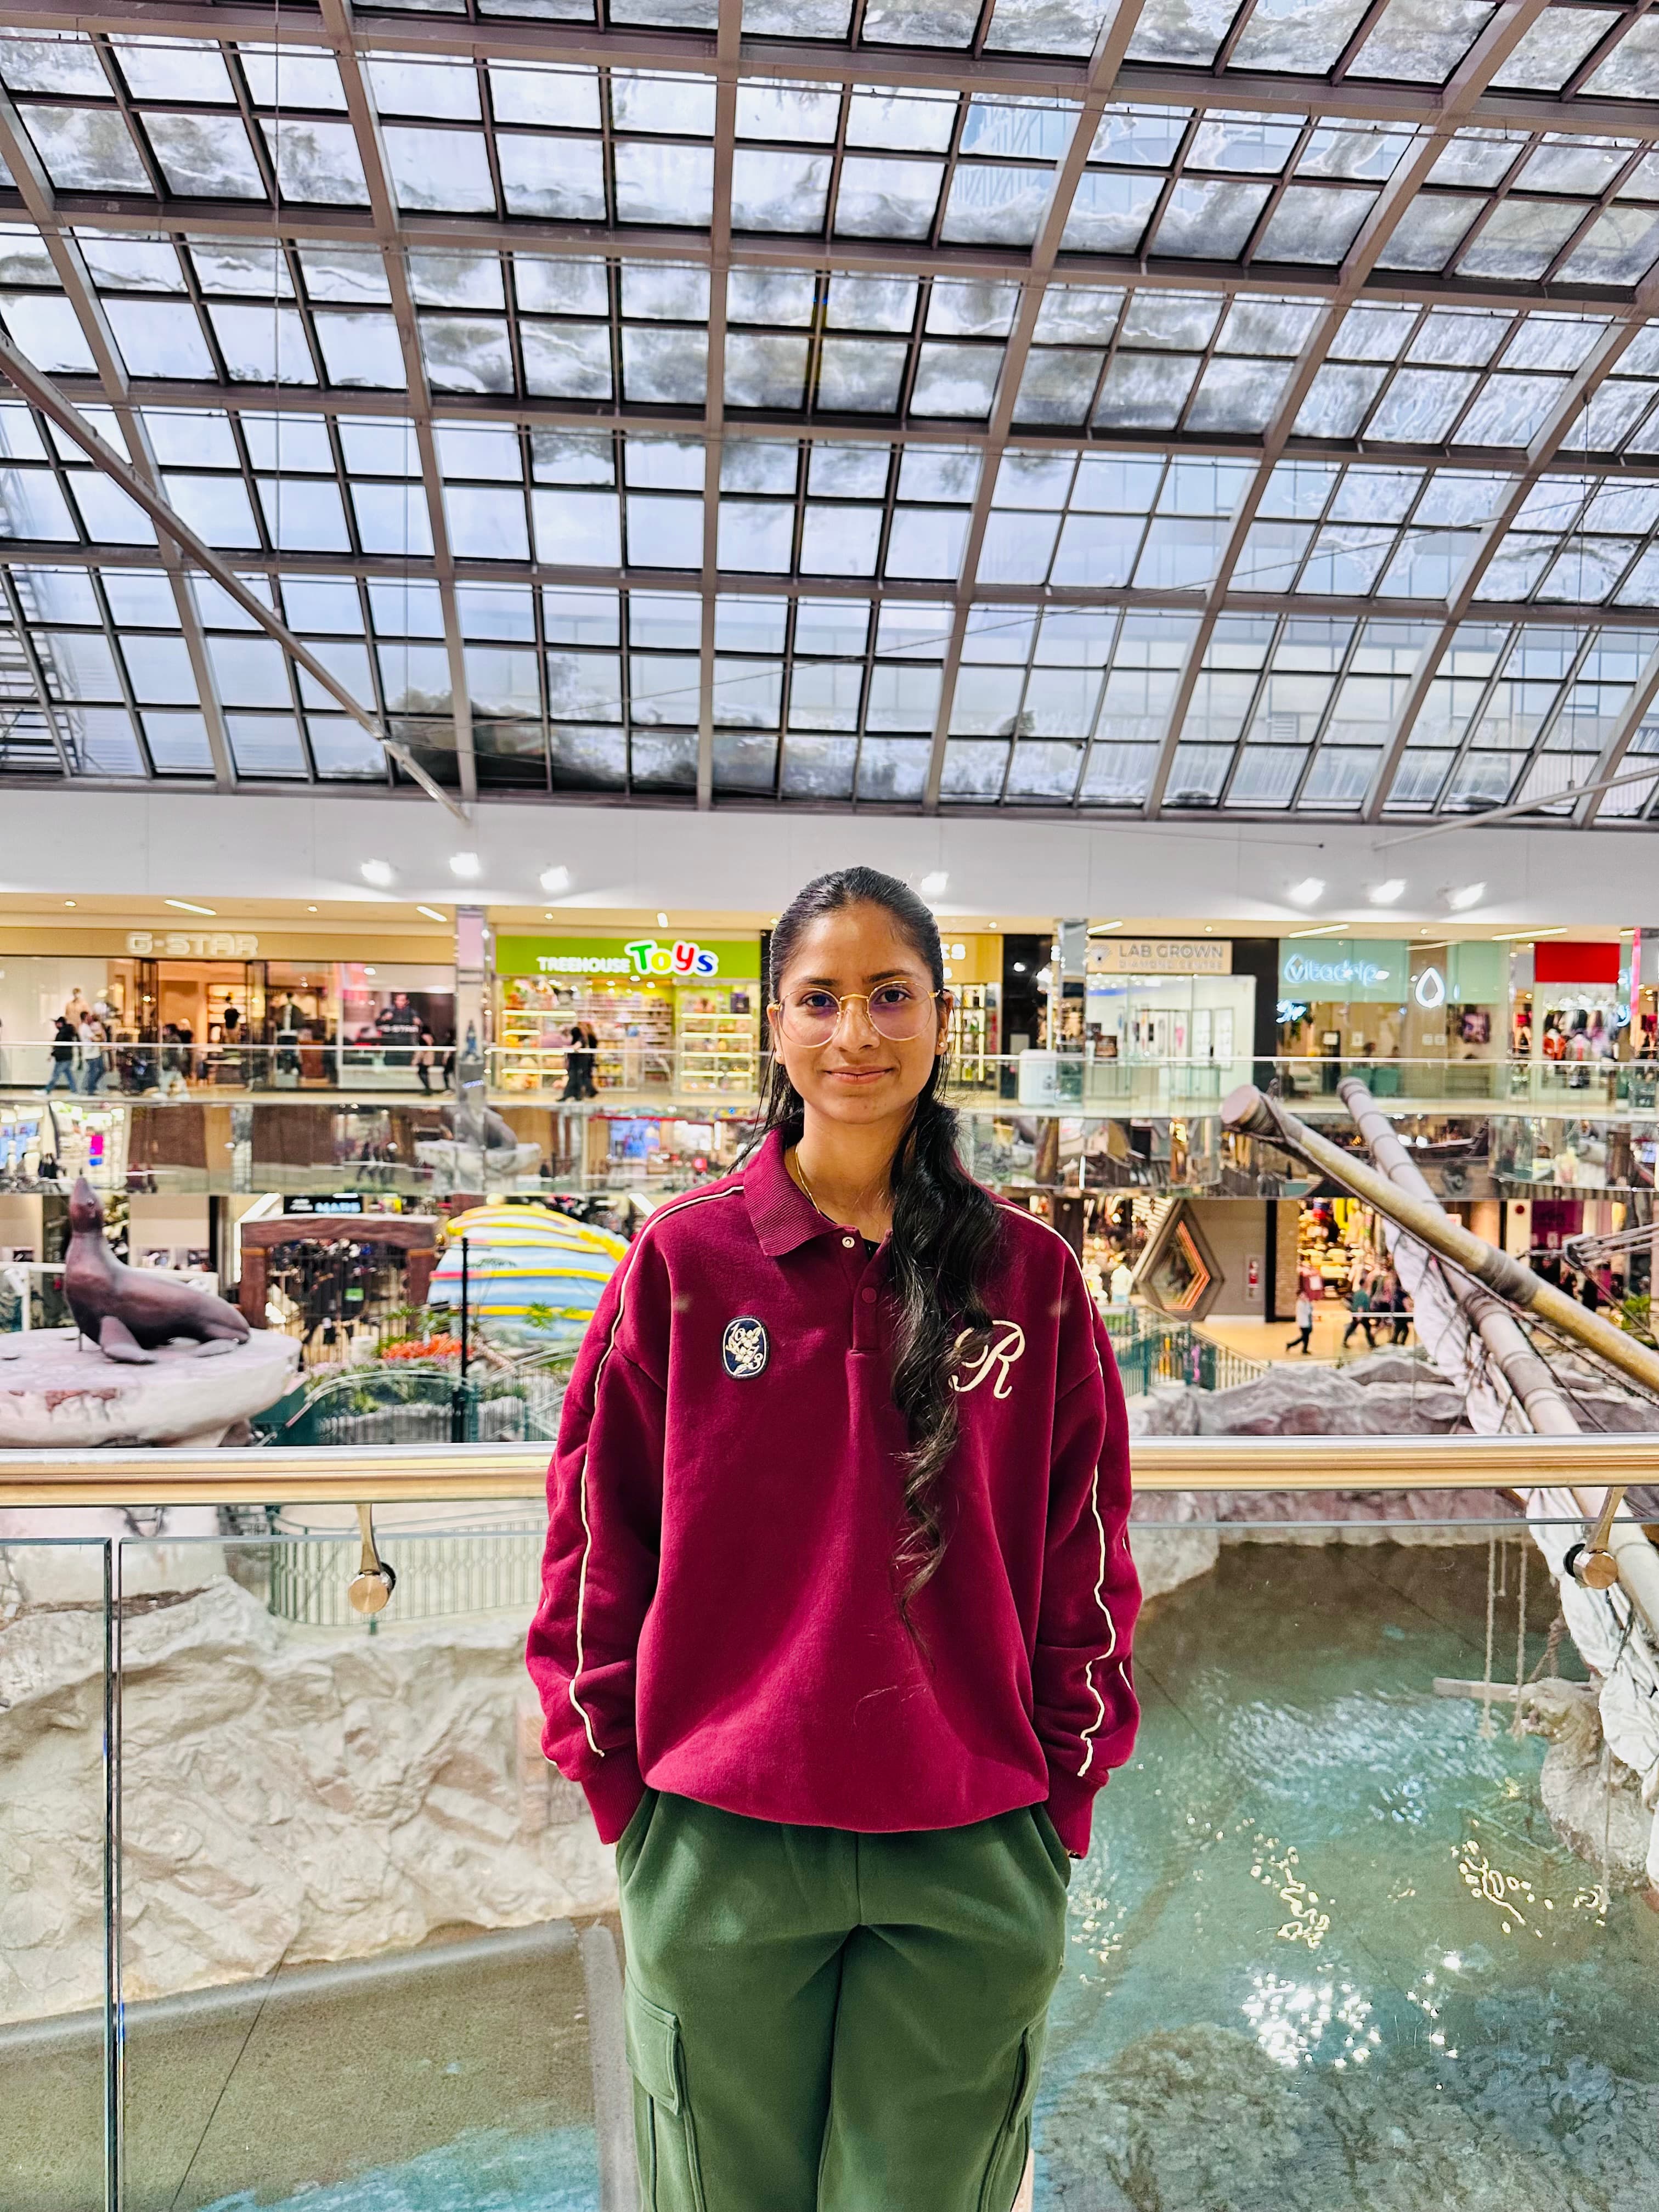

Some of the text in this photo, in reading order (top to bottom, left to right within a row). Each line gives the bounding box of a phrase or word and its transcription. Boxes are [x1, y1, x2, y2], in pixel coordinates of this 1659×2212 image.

[128, 932, 258, 956] G-STAR
[1119, 944, 1223, 958] LAB GROWN
[537, 956, 630, 973] TREEHOUSE
